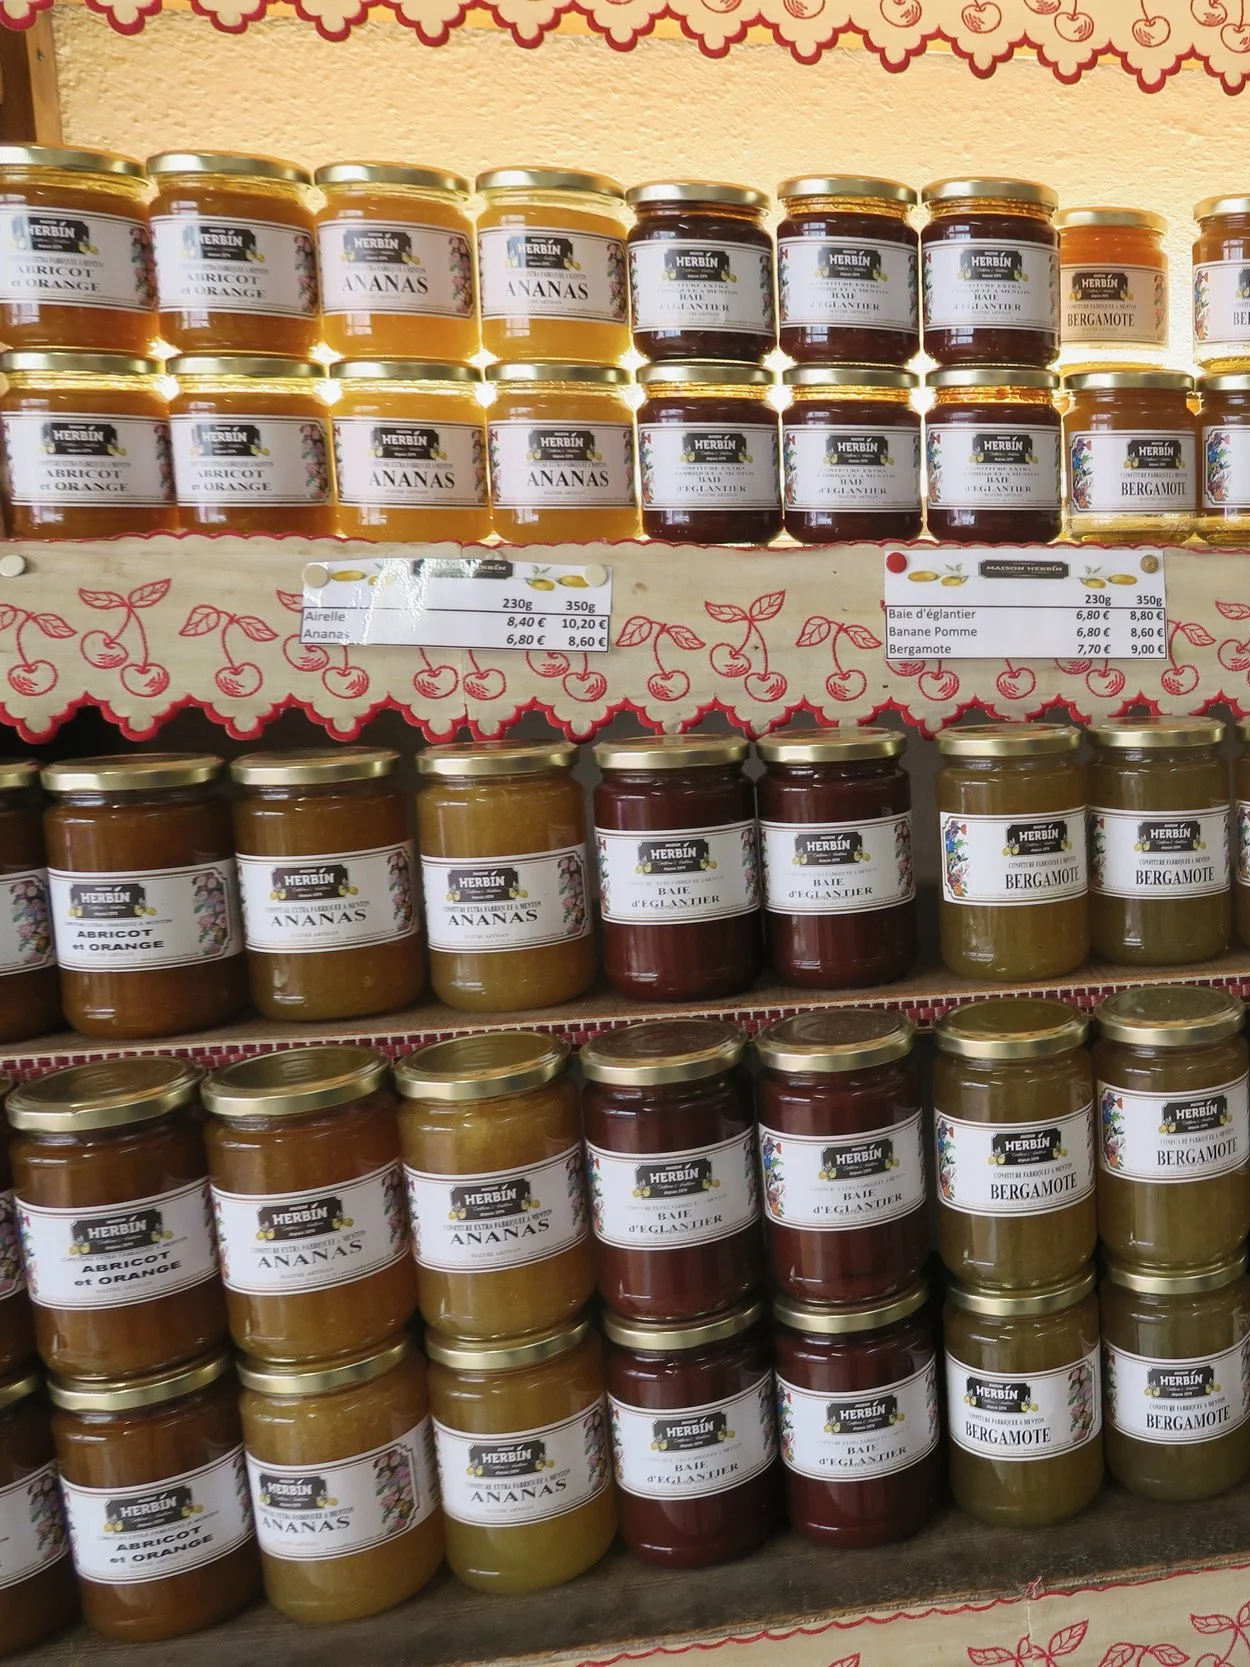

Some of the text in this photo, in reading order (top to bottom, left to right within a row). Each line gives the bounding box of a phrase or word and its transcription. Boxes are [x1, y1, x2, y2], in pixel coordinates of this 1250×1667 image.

[829, 255, 870, 268] HERBIN
[342, 274, 428, 294] ANANAS
[505, 279, 588, 300] ANANAS
[1067, 312, 1135, 328] BERGAMOTE
[541, 436, 584, 448] HERBIN
[694, 439, 736, 452] HERBIN
[371, 470, 455, 490] ANANAS
[527, 470, 609, 488] ANANAS
[1121, 479, 1186, 496] BERGAMOTE
[502, 599, 596, 614] 230g 350g
[1085, 595, 1162, 606] 230g 350g
[305, 611, 607, 630] Airelle 8,40 € 10,20 €
[889, 609, 1164, 622] Baie d'églantier 6,80 € 8,80 €
[303, 629, 607, 647] Ananas 6,80 € 8,60 €
[889, 627, 1164, 639] Banane Pomme 6,80 € 8,60 €
[889, 645, 1165, 656] Bergamote 7,70 € 9,00 €
[1019, 828, 1059, 842] HERBIN
[1150, 828, 1191, 840] HERBIN
[651, 846, 696, 860] HERBIN
[806, 838, 851, 852] HERBIN
[284, 871, 336, 887] HERBIN
[458, 873, 506, 890] HERBIN
[813, 877, 845, 887] BAIE
[1005, 865, 1080, 890] BERGAMOTE
[1135, 867, 1215, 886] BERGAMOTE
[658, 886, 691, 896] BAIE
[270, 908, 367, 928] ANANAS
[448, 908, 539, 928] ANANAS
[76, 928, 154, 940] ABRICOT
[72, 939, 164, 952] et ORANGE
[1176, 1105, 1217, 1119] HERBIN
[1005, 1137, 1050, 1151] HERBIN
[1157, 1137, 1238, 1166] BERGAMOTE
[990, 1172, 1078, 1200] BERGAMOTE
[464, 1188, 516, 1205] HERBIN
[843, 1189, 876, 1201] BAIE
[272, 1206, 328, 1226] HERBIN
[657, 1209, 692, 1220] BAIE
[87, 1220, 147, 1239] HERBIN
[450, 1218, 550, 1245] ANANAS
[81, 1250, 170, 1274] ABRICOT
[257, 1240, 364, 1270] ANANAS
[75, 1259, 182, 1287] et ORANGE
[1160, 1371, 1202, 1385] HERBIN
[976, 1385, 1018, 1400] HERBIN
[1146, 1406, 1231, 1431] BERGAMOTE
[666, 1420, 714, 1437] HERBIN
[966, 1421, 1051, 1445] BERGAMOTE
[481, 1447, 532, 1464] HERBIN
[847, 1443, 879, 1454] BAIE
[674, 1460, 708, 1472] BAIE
[470, 1477, 568, 1505] ANANAS
[262, 1512, 351, 1534] ANANAS
[116, 1525, 201, 1553] ABRICOT
[109, 1533, 214, 1564] et ORANGE
